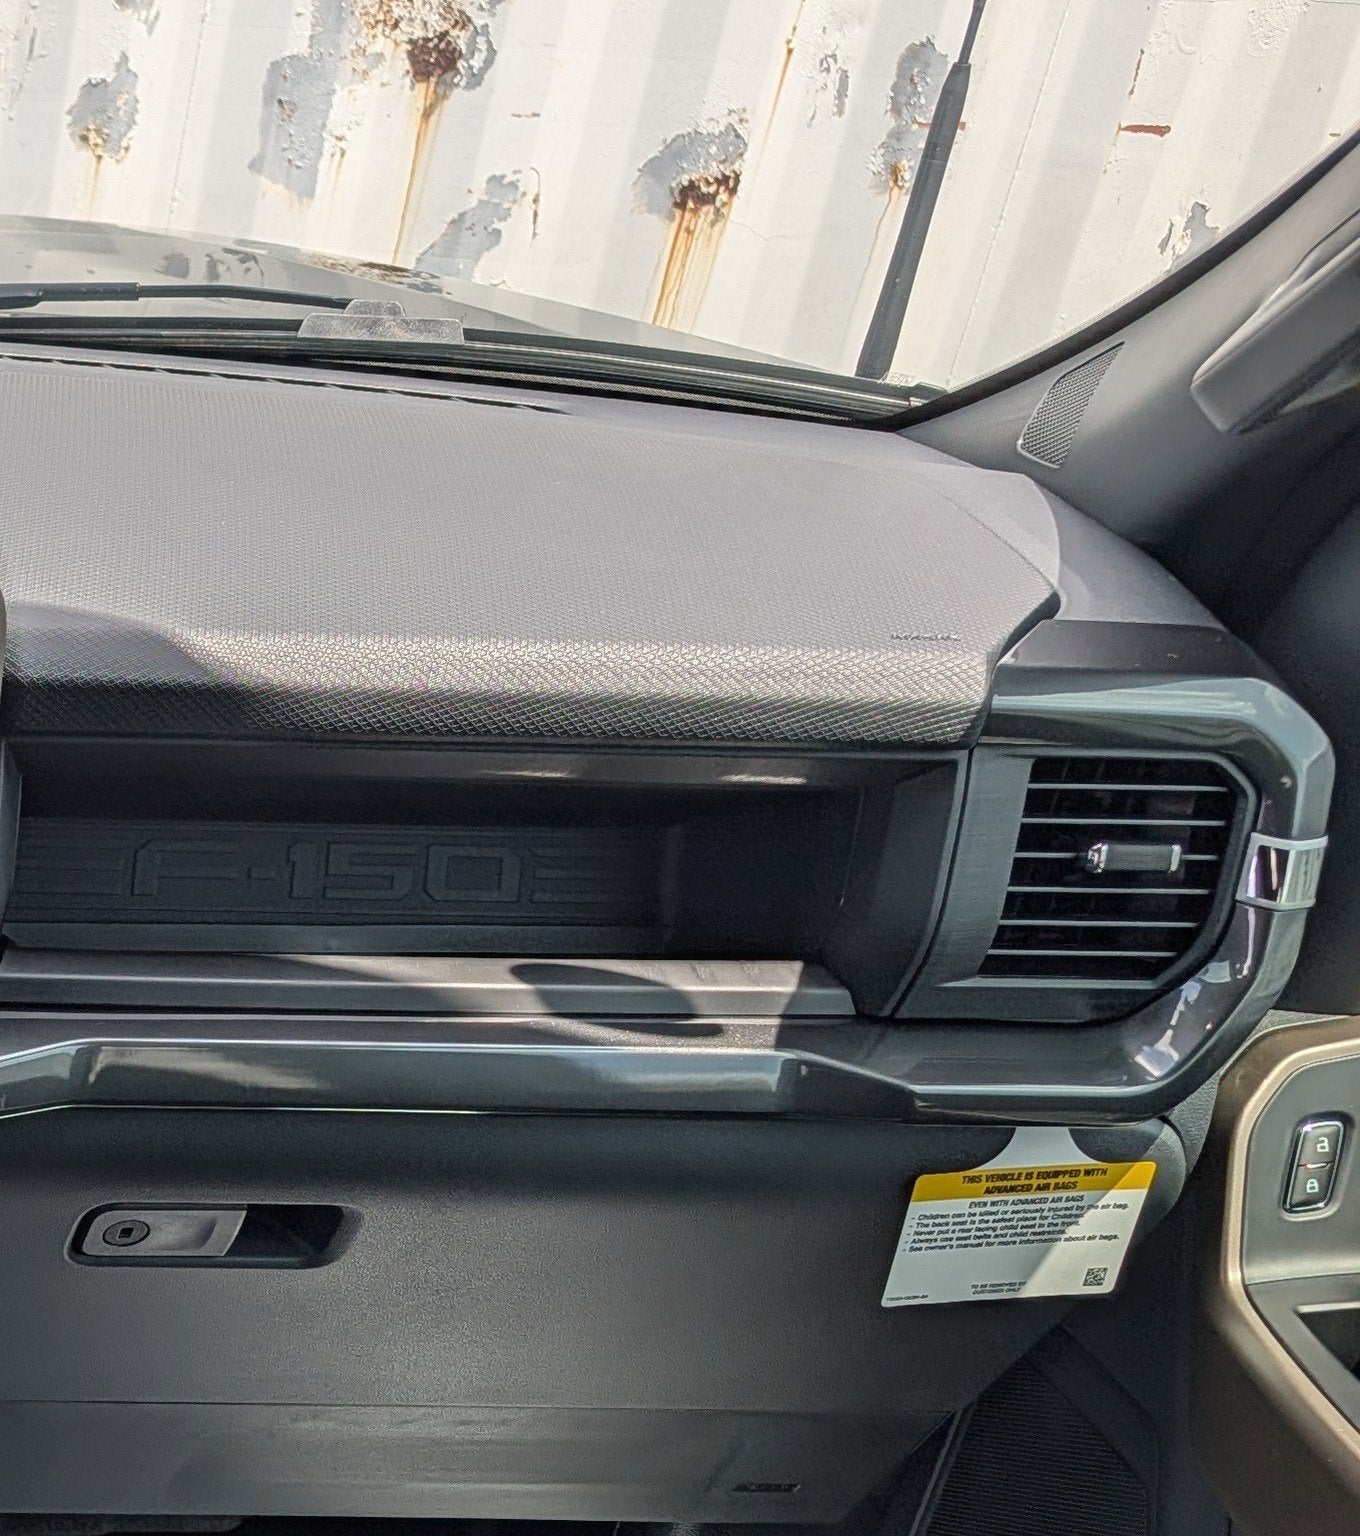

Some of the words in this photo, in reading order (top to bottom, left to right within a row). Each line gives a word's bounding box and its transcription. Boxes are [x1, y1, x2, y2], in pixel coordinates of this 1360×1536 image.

[131, 840, 523, 905] F-150
[985, 1172, 1022, 1183] VEHICLE
[1023, 1172, 1033, 1181] IS
[1036, 1169, 1080, 1180] EQUIPPED
[1083, 1168, 1108, 1177] WITH
[983, 1183, 1033, 1195] ADVANCED
[1035, 1182, 1051, 1192] AIR
[1052, 1181, 1078, 1191] BAGS
[969, 1201, 988, 1209] EVEN
[990, 1199, 1009, 1208] WITH
[1010, 1197, 1049, 1206] ADVANCED
[1050, 1196, 1063, 1204] AIR
